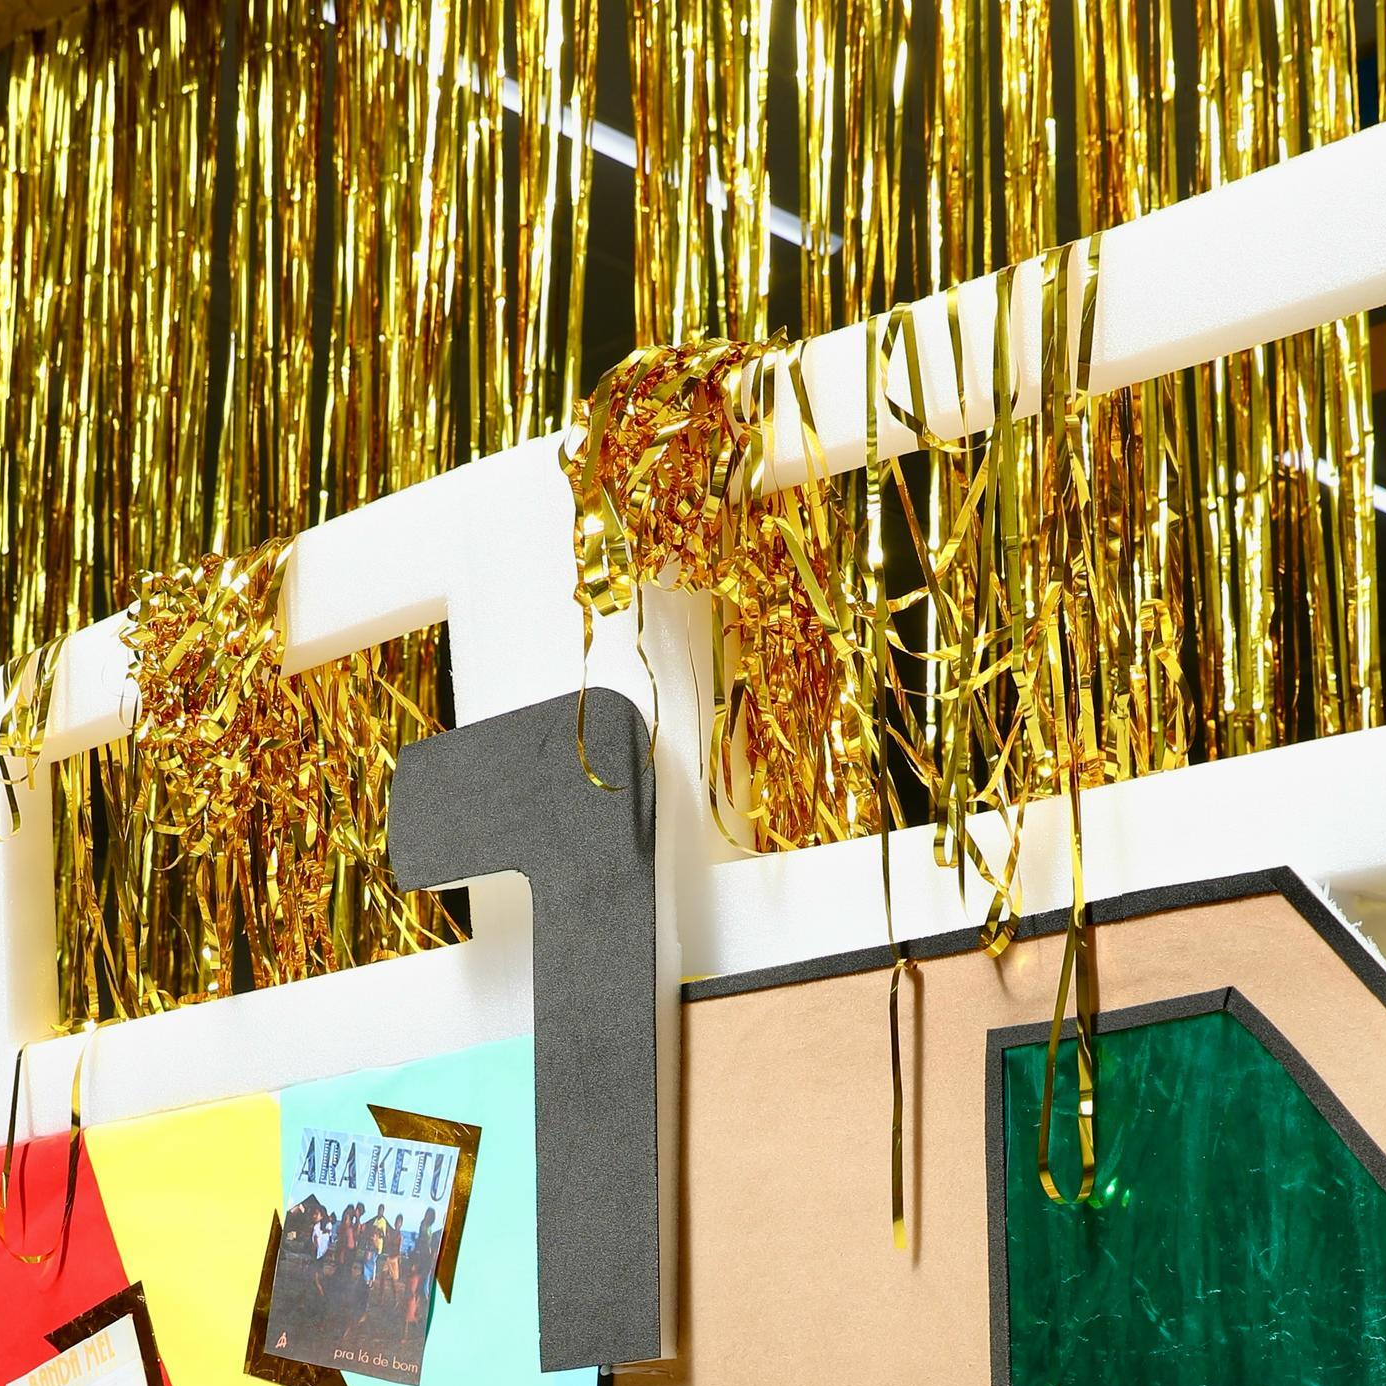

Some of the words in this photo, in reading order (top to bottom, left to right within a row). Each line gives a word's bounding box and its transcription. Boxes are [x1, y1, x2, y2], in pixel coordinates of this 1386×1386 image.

[297, 1136, 358, 1190] ARA
[366, 1145, 453, 1202] KETU
[82, 1330, 116, 1374] MEL
[333, 1348, 354, 1362] pra
[357, 1348, 370, 1364] lá
[372, 1350, 389, 1367] de
[392, 1356, 419, 1374] bom
